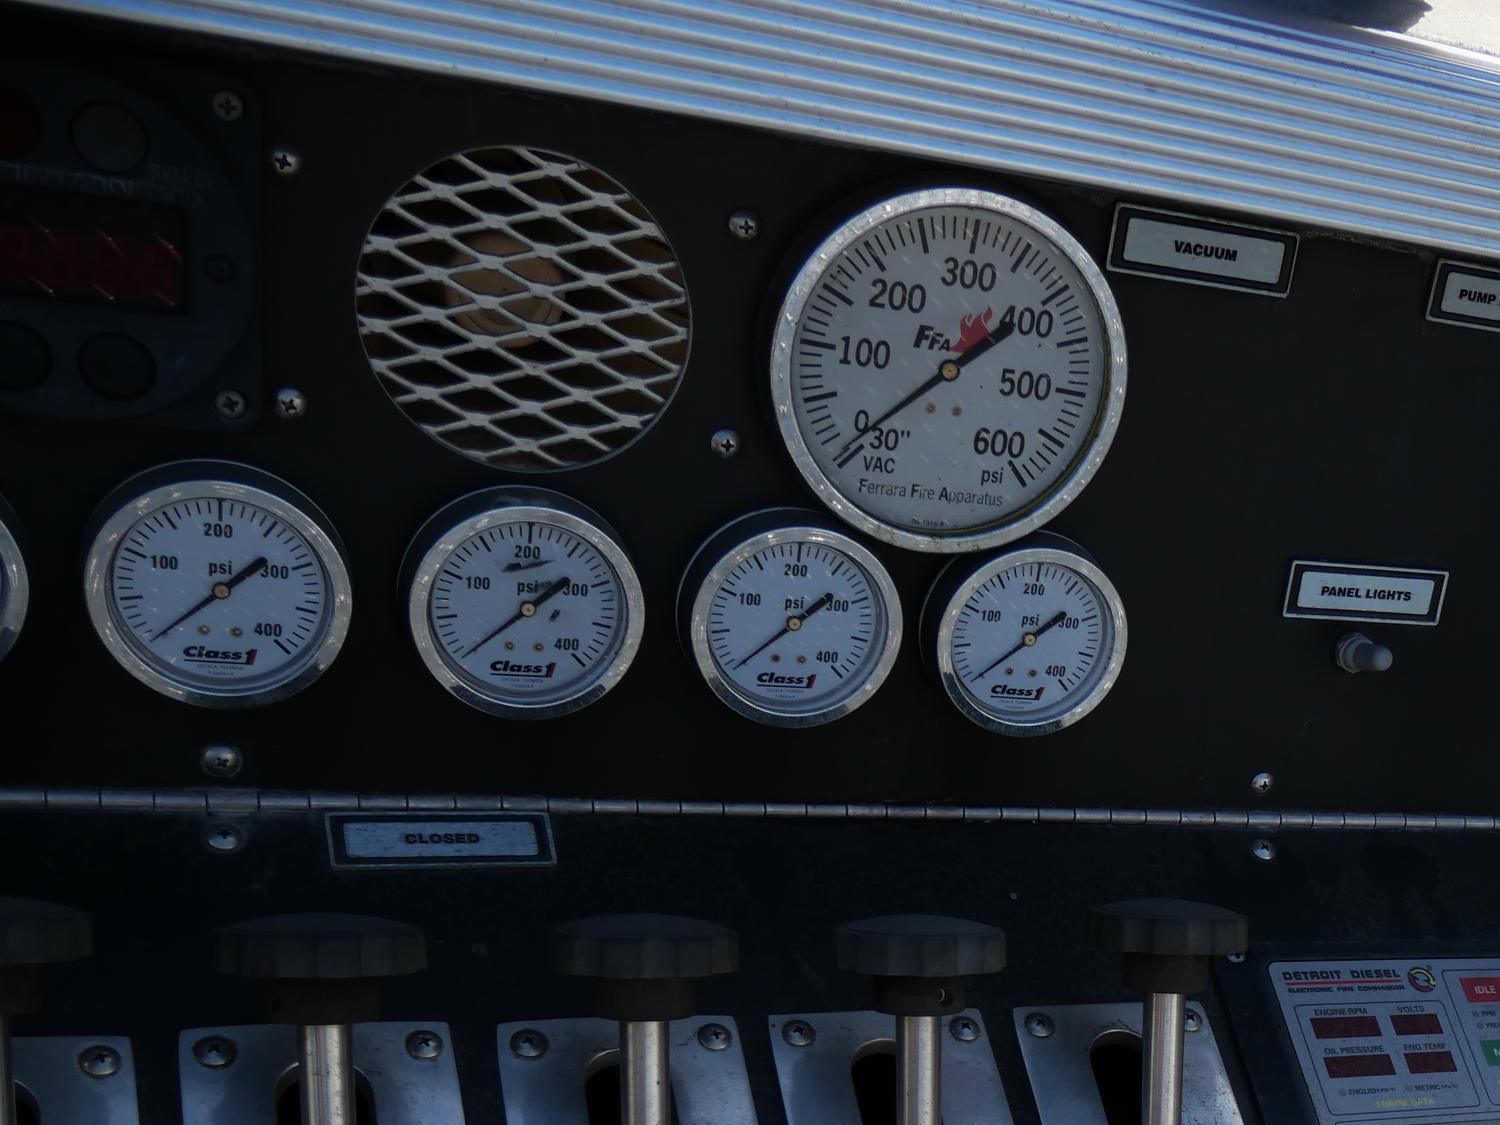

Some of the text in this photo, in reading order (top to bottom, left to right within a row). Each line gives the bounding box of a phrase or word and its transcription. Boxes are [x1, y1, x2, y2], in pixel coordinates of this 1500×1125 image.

[1173, 240, 1237, 262] VACUUM
[941, 256, 996, 291] 300
[869, 278, 926, 313] 200
[1458, 289, 1497, 305] PUMP
[1001, 305, 1053, 339] 400
[838, 336, 890, 369] 100
[999, 369, 1051, 401] 500
[973, 428, 1025, 458] 600
[863, 455, 895, 473] VAC
[981, 461, 1003, 485] psi
[858, 478, 1002, 508] Ferrara Fire Apparatus
[203, 523, 233, 539] 200
[514, 545, 541, 559] 200
[151, 555, 178, 570] 100
[209, 560, 232, 577] psi
[784, 564, 808, 576] 200
[260, 565, 289, 580] 300
[465, 577, 490, 590] 100
[517, 580, 539, 595] psi
[563, 581, 588, 596] 300
[1024, 583, 1045, 595] 200
[739, 593, 761, 605] 100
[1321, 586, 1412, 601] PANEL LIGHTS
[784, 597, 804, 612] psi
[826, 600, 849, 612] 300
[981, 610, 1001, 622] 100
[1021, 615, 1040, 628] psi
[1058, 617, 1079, 629] 300
[254, 623, 282, 637] 400
[555, 638, 579, 650] 400
[816, 651, 838, 663] 400
[1045, 666, 1065, 677] 400
[404, 833, 480, 844] CLOSED
[1282, 969, 1401, 980] DETROIT DIESEL
[1474, 985, 1497, 994] IDLE
[1397, 1005, 1425, 1013] VOLTS
[1324, 1045, 1385, 1055] OIL PRESSURE
